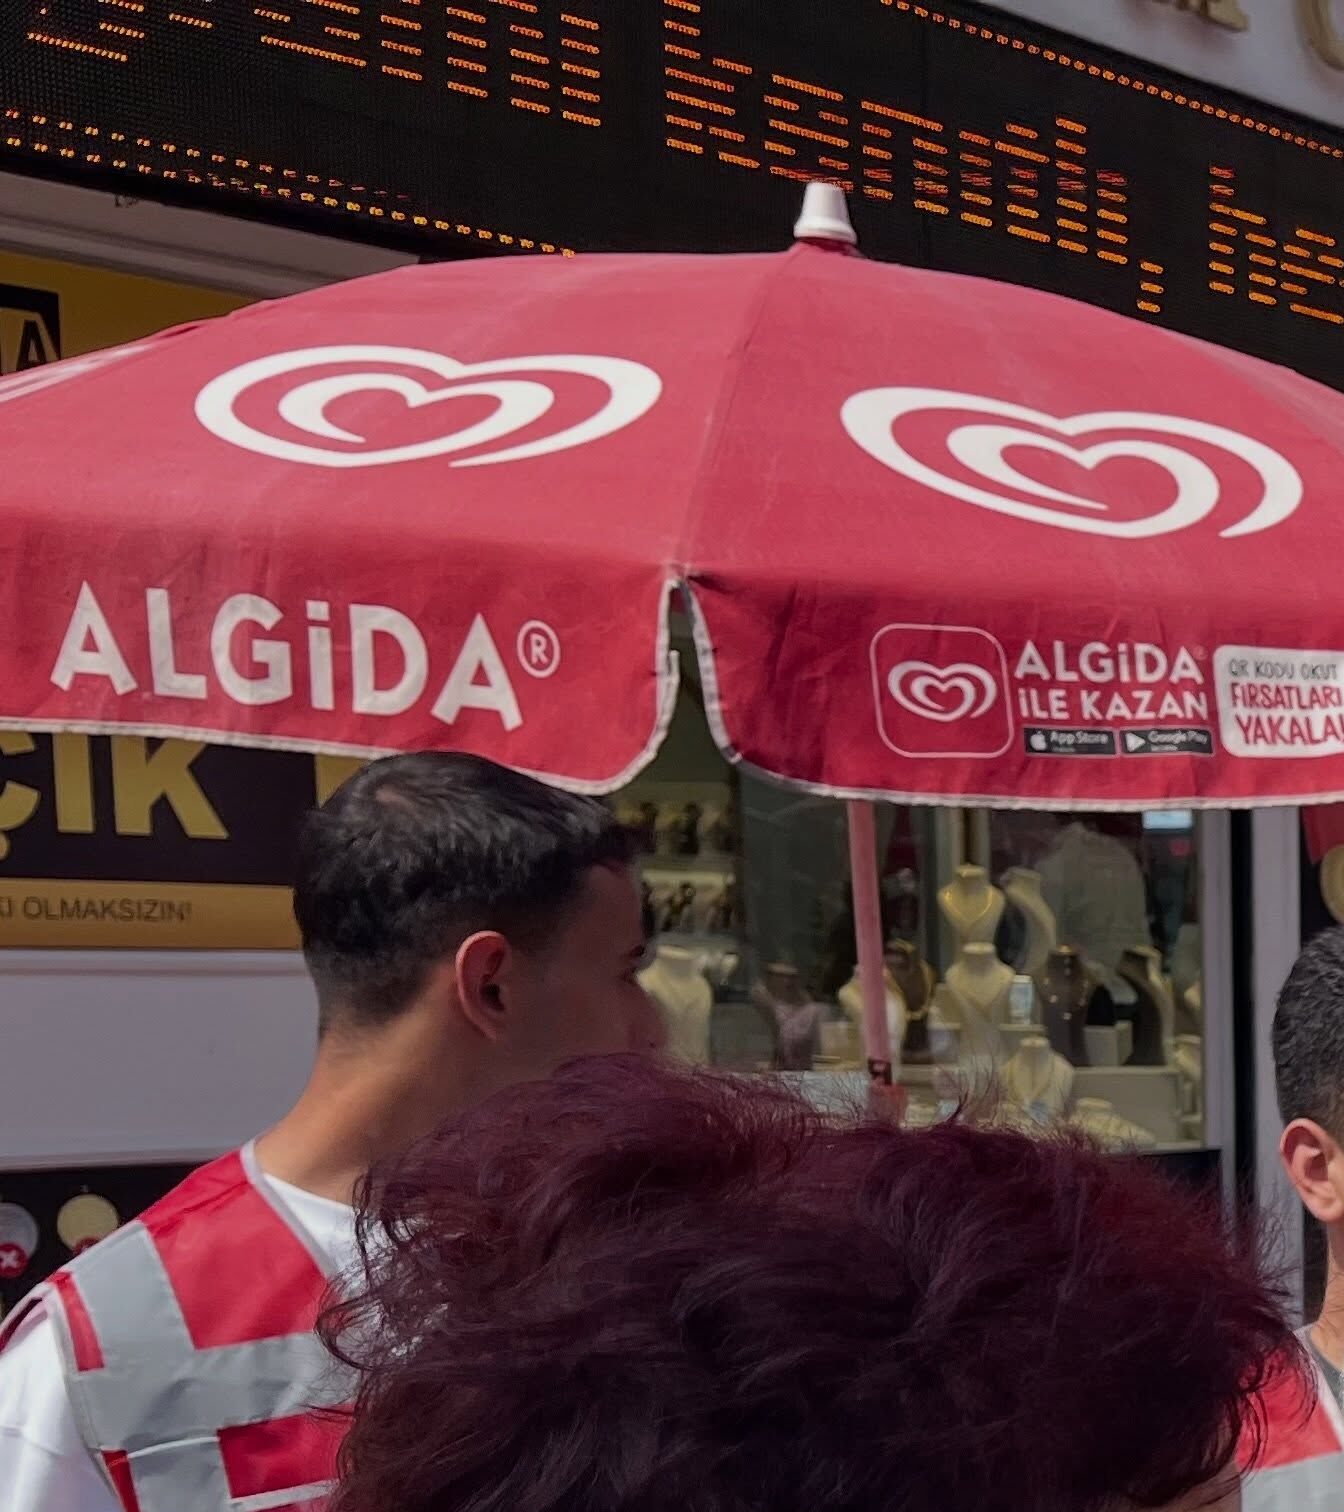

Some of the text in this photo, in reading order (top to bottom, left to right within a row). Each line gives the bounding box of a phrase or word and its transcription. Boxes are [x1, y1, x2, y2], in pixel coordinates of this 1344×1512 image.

[1254, 661, 1295, 680] KODU
[1081, 690, 1209, 721] KAZAN
[1230, 682, 1344, 709] FIRSATLARI
